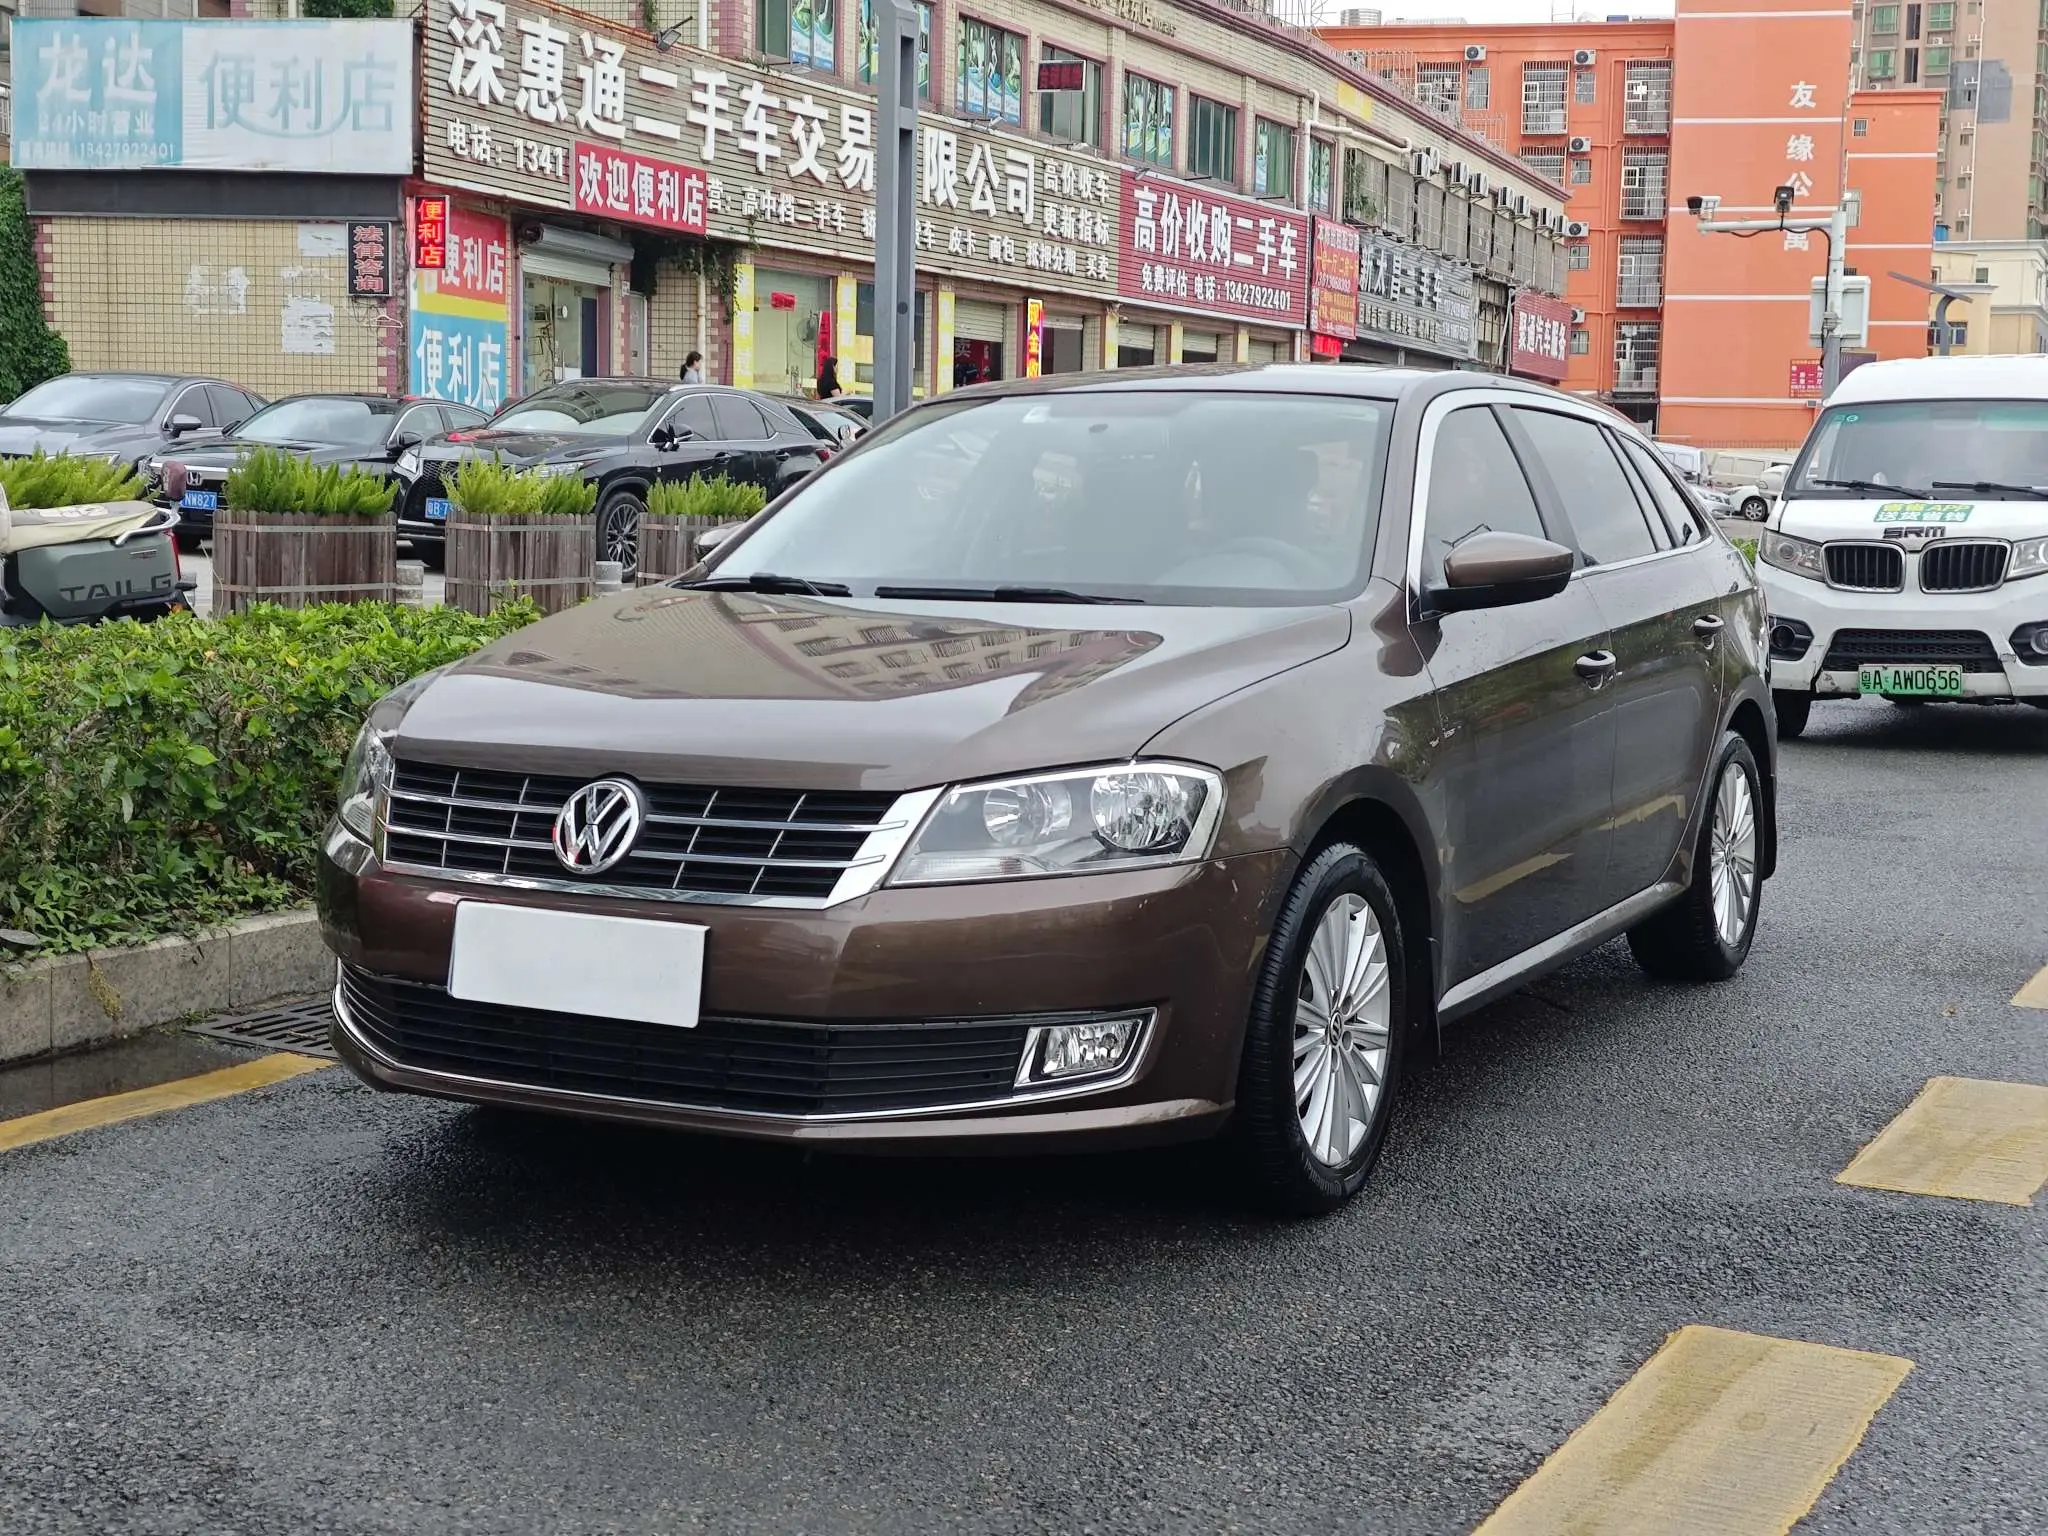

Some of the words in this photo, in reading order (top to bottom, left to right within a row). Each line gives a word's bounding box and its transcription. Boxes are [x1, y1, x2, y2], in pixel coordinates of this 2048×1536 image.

[37, 30, 156, 103] 龙达
[202, 52, 398, 133] 便利店
[447, 0, 1035, 225] 深惠通二手车交易限公司
[578, 150, 704, 228] 欢迎便利店
[1043, 158, 1110, 204] 高价收车
[418, 199, 444, 266] 便利店
[742, 185, 847, 233] 高中档二手车
[948, 226, 976, 256] 皮卡
[988, 233, 1015, 264] 面包
[1042, 201, 1110, 245] 更新指标
[1134, 186, 1298, 280] 高价收购二手车
[353, 225, 384, 292] 法律咨询
[442, 233, 504, 294] 便利店
[1142, 262, 1187, 297] 免费评估
[416, 326, 501, 409] 便利店
[1883, 526, 1946, 538] SRM
[60, 573, 171, 601] TAILG
